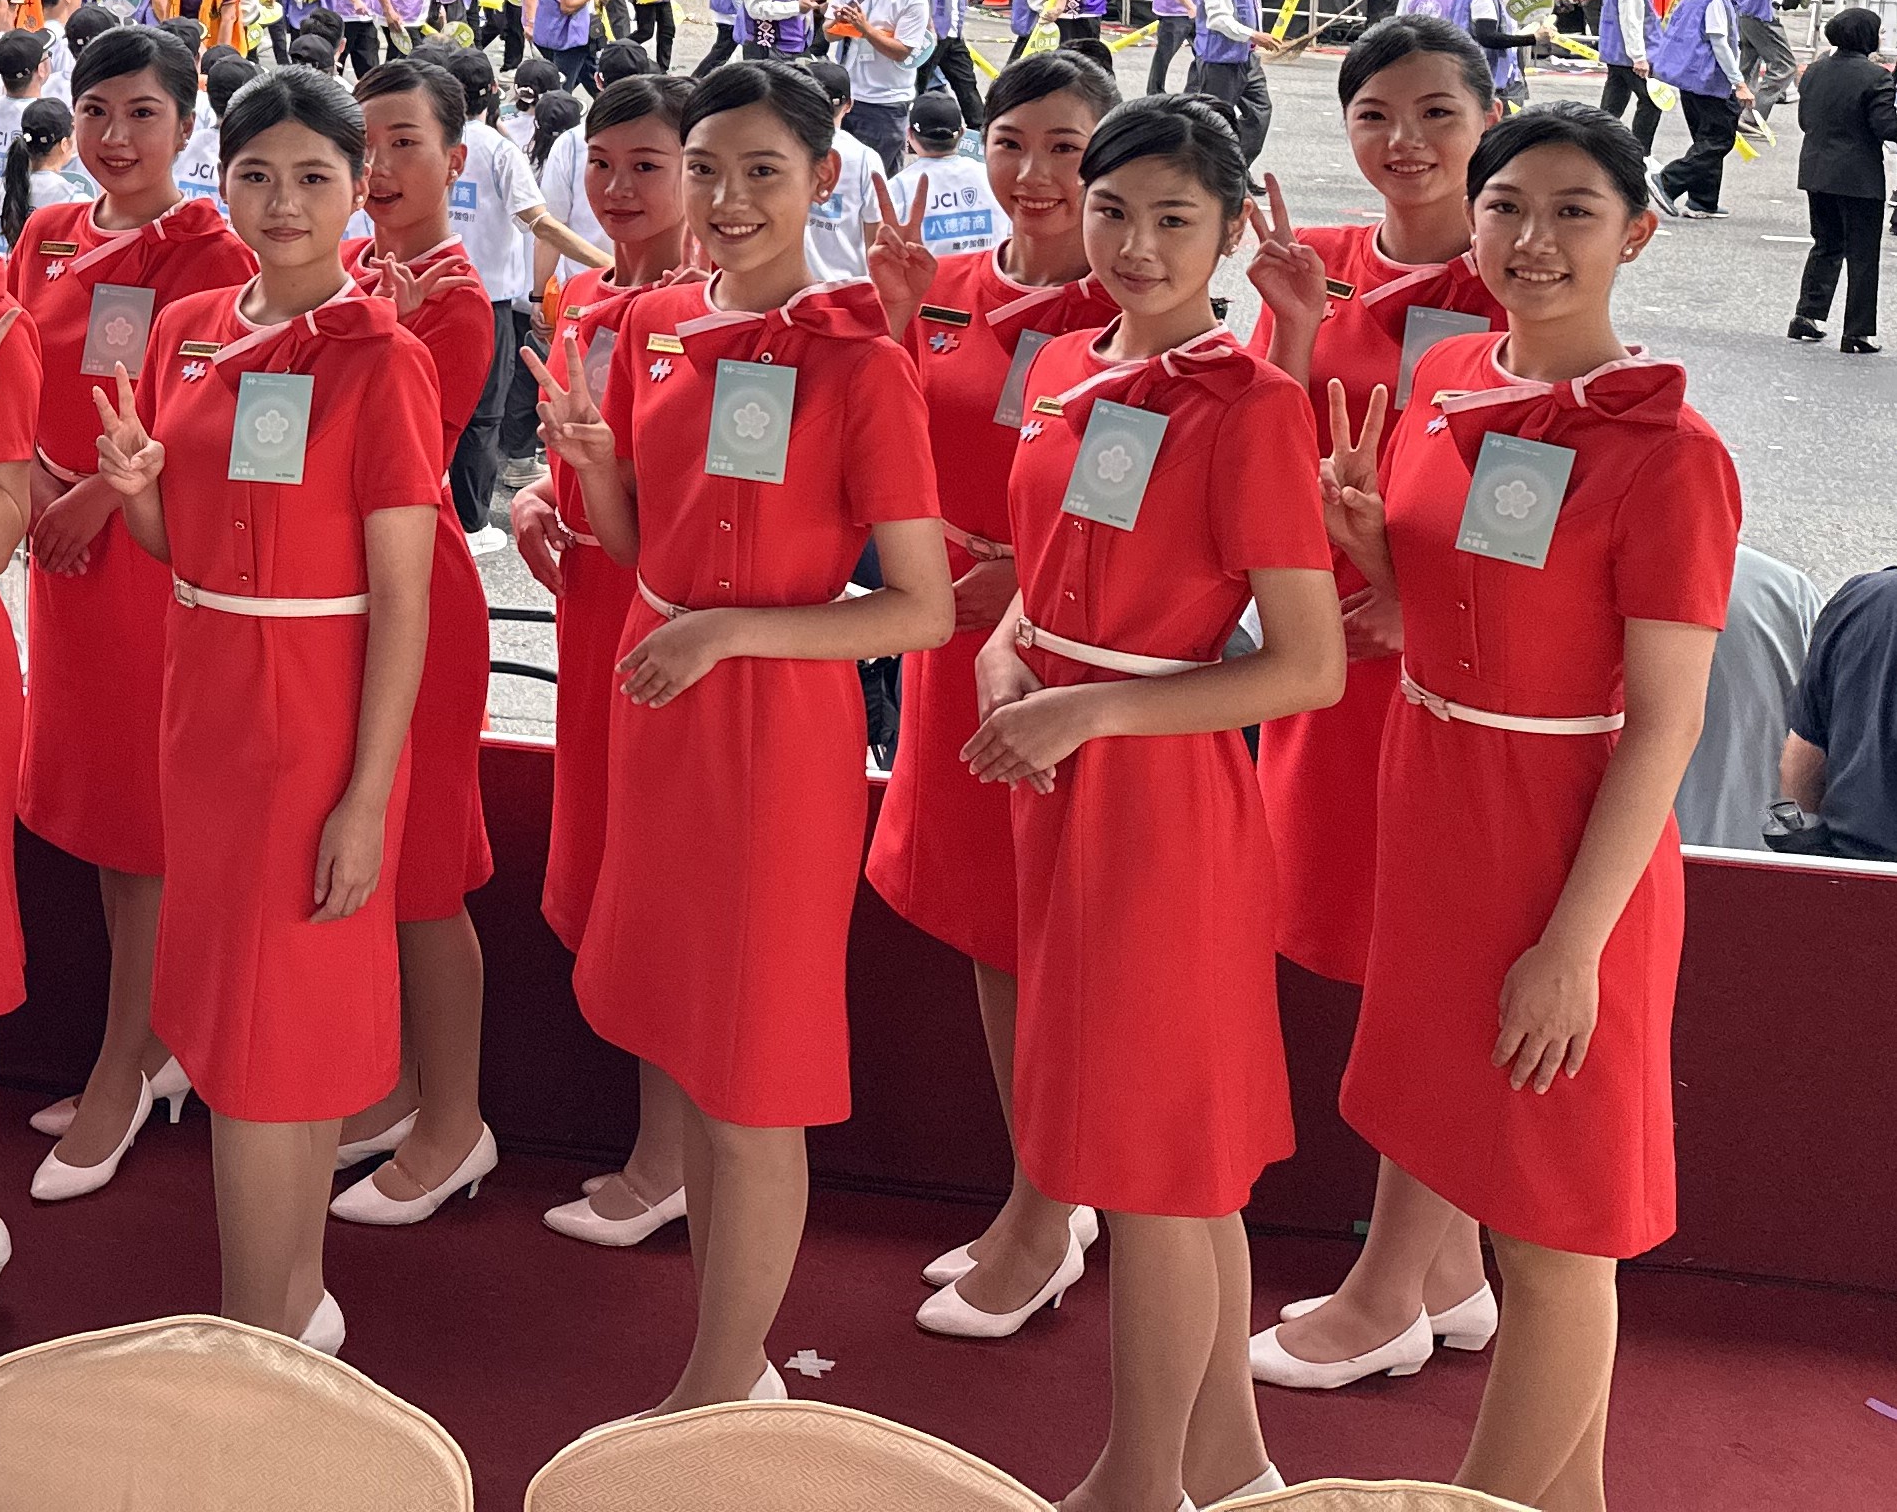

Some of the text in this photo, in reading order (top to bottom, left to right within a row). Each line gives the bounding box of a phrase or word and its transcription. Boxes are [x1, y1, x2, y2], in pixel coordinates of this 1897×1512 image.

[189, 163, 214, 180] JCI
[931, 192, 958, 209] JCI
[930, 215, 986, 236] 八德青商
